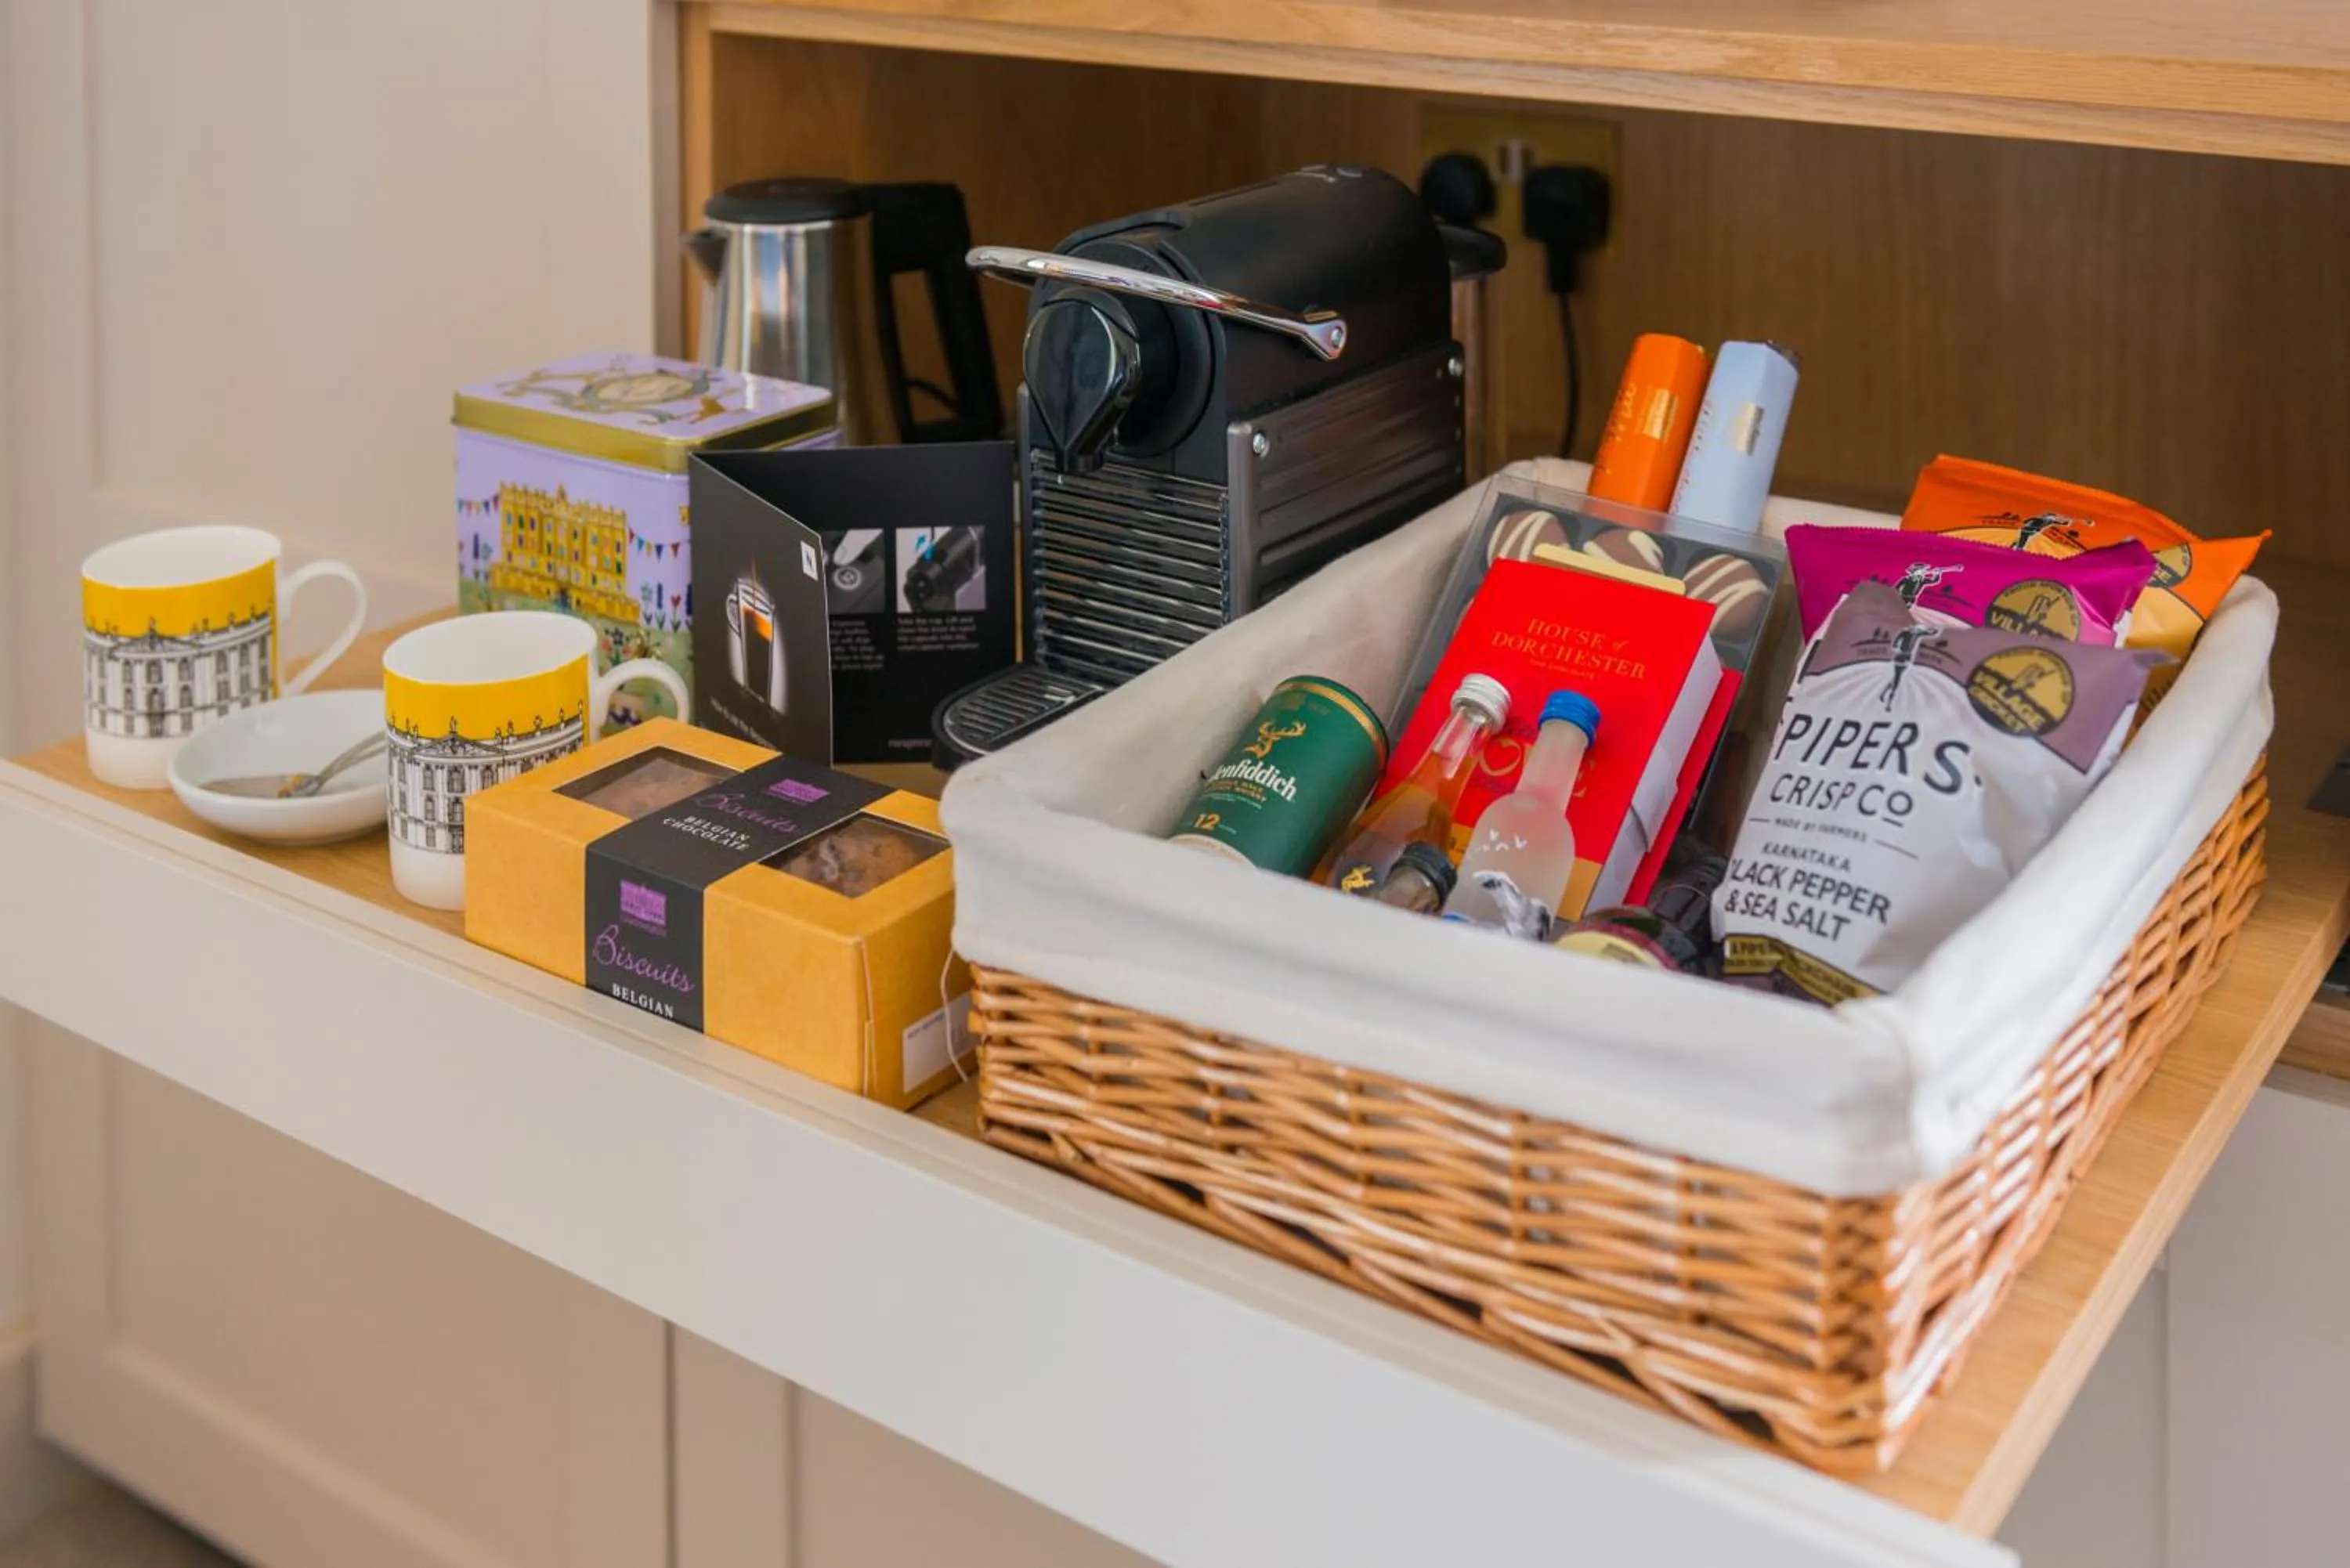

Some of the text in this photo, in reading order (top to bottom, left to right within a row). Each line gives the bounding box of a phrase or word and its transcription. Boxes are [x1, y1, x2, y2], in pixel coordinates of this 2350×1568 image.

[1528, 617, 1605, 650] HOUSE
[1491, 630, 1646, 680] DORCHESTER
[1774, 713, 1971, 795] PIPERS
[1207, 758, 1297, 803] enfiddich
[1770, 773, 1856, 811] CRISP
[683, 815, 750, 841] BELGIAN
[693, 792, 801, 833] Biscuits
[1193, 812, 1221, 831] 12
[663, 816, 750, 851] CHOCOLATE
[1762, 841, 1852, 873] KARNATAKA
[1730, 858, 1892, 924] LACK PEPPER
[1739, 891, 1778, 922] SEA
[1781, 901, 1852, 941] SALT
[592, 924, 696, 992] Biscuits
[612, 982, 674, 1019] BELGIAN
